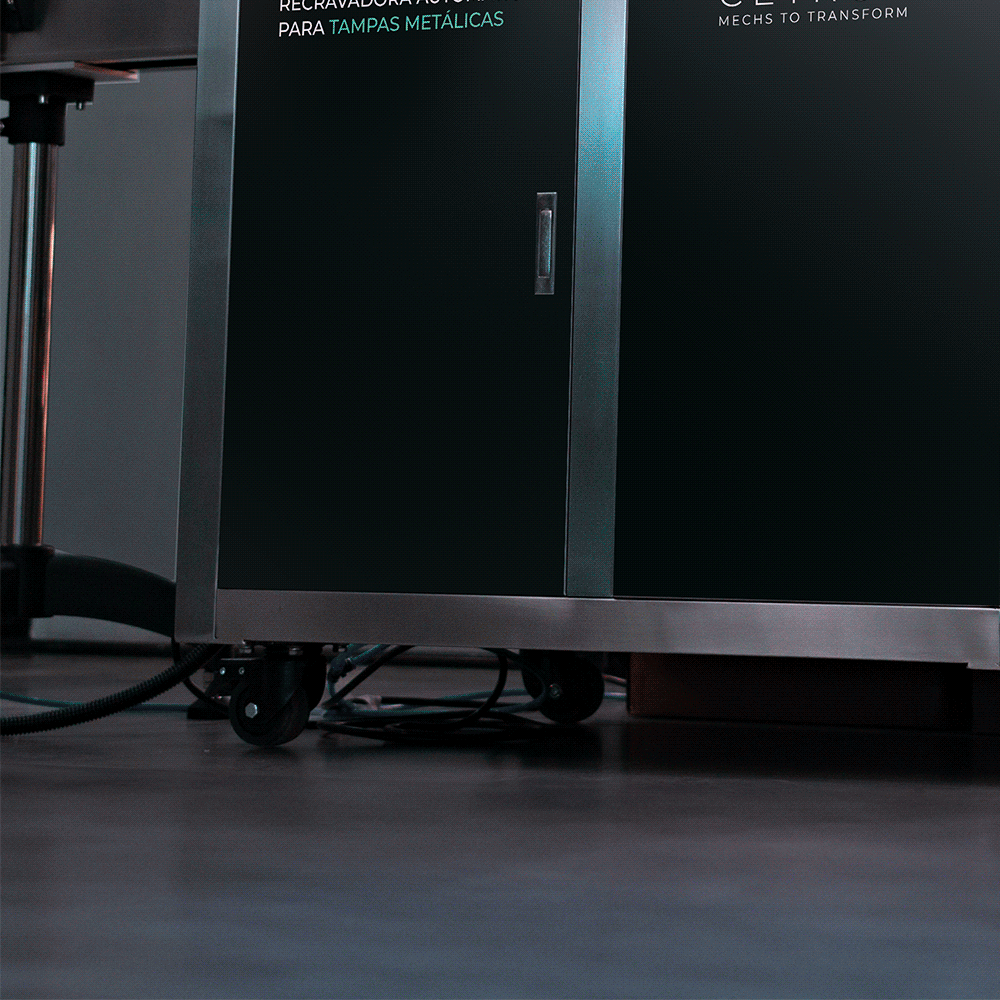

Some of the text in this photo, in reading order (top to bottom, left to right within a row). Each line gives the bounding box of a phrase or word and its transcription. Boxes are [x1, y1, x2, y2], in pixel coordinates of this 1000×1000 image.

[278, 9, 505, 38] PARA TAMPAS METÁLICAS
[718, 6, 908, 27] MECHS TO TRANSFORM
